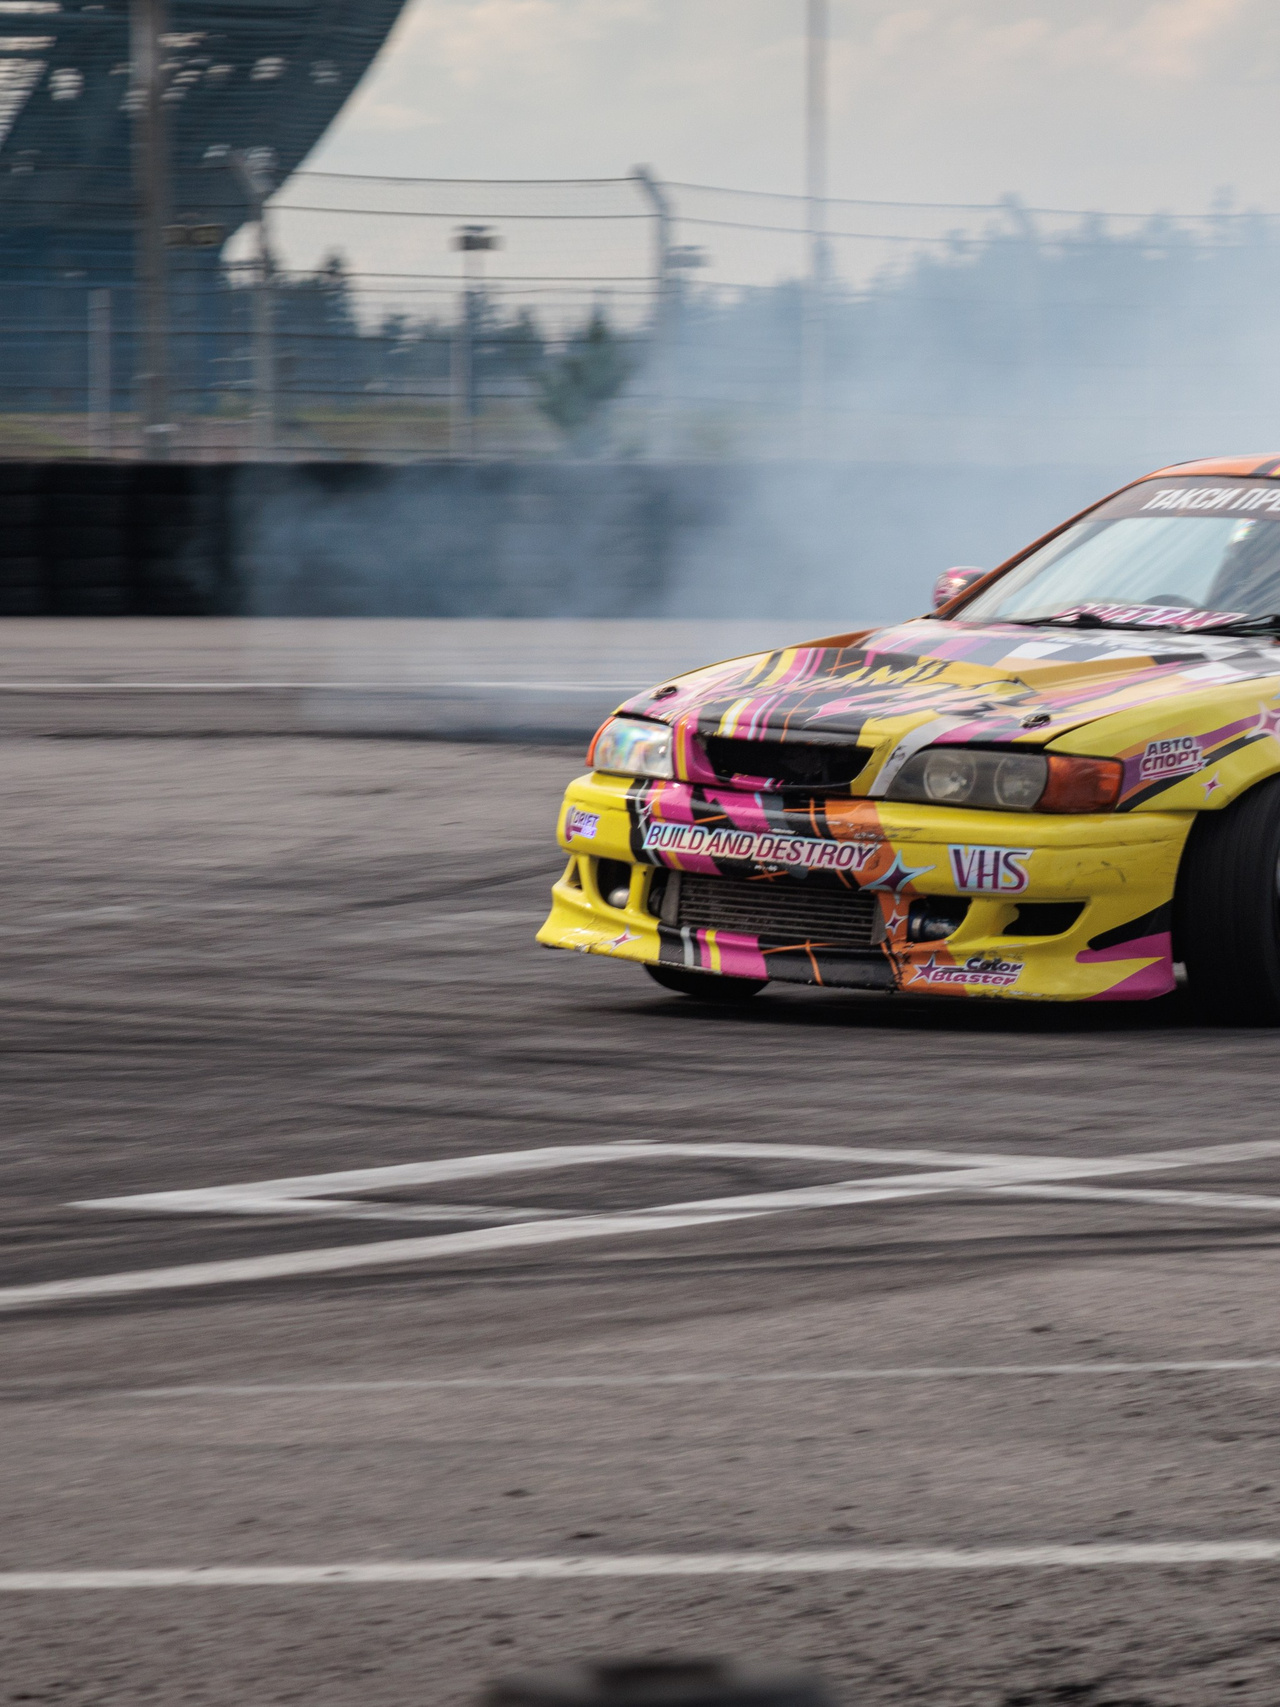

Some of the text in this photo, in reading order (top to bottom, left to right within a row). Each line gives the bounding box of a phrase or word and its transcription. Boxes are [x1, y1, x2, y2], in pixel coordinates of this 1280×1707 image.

[1140, 487, 1240, 511] ТАКСИ
[1146, 737, 1194, 757] АВТО
[1142, 749, 1200, 772] СПОРТ
[645, 825, 876, 870] BUILD AND DESTROY
[952, 848, 1029, 890] VHS
[966, 957, 1023, 974] Color
[931, 971, 1019, 987] Blaster
